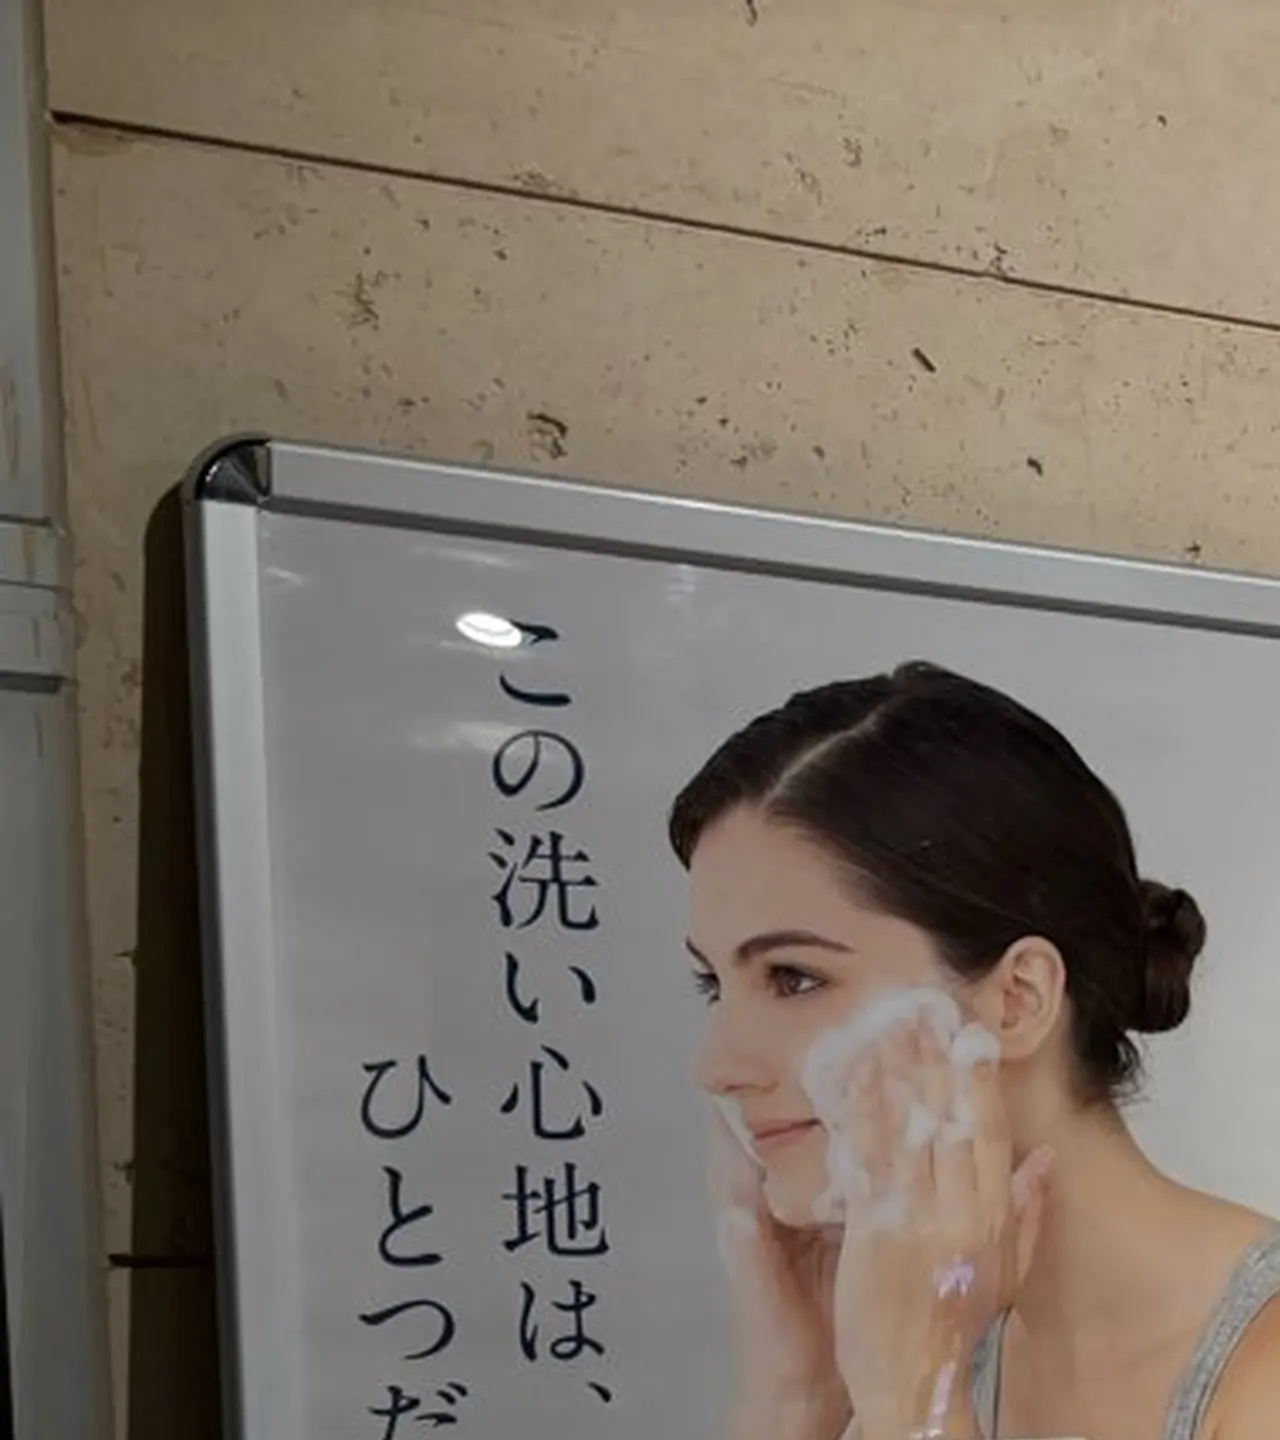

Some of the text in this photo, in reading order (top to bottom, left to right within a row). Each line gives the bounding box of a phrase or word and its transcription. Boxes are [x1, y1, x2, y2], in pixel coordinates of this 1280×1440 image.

[487, 617, 613, 1404] この洗い心地は、
